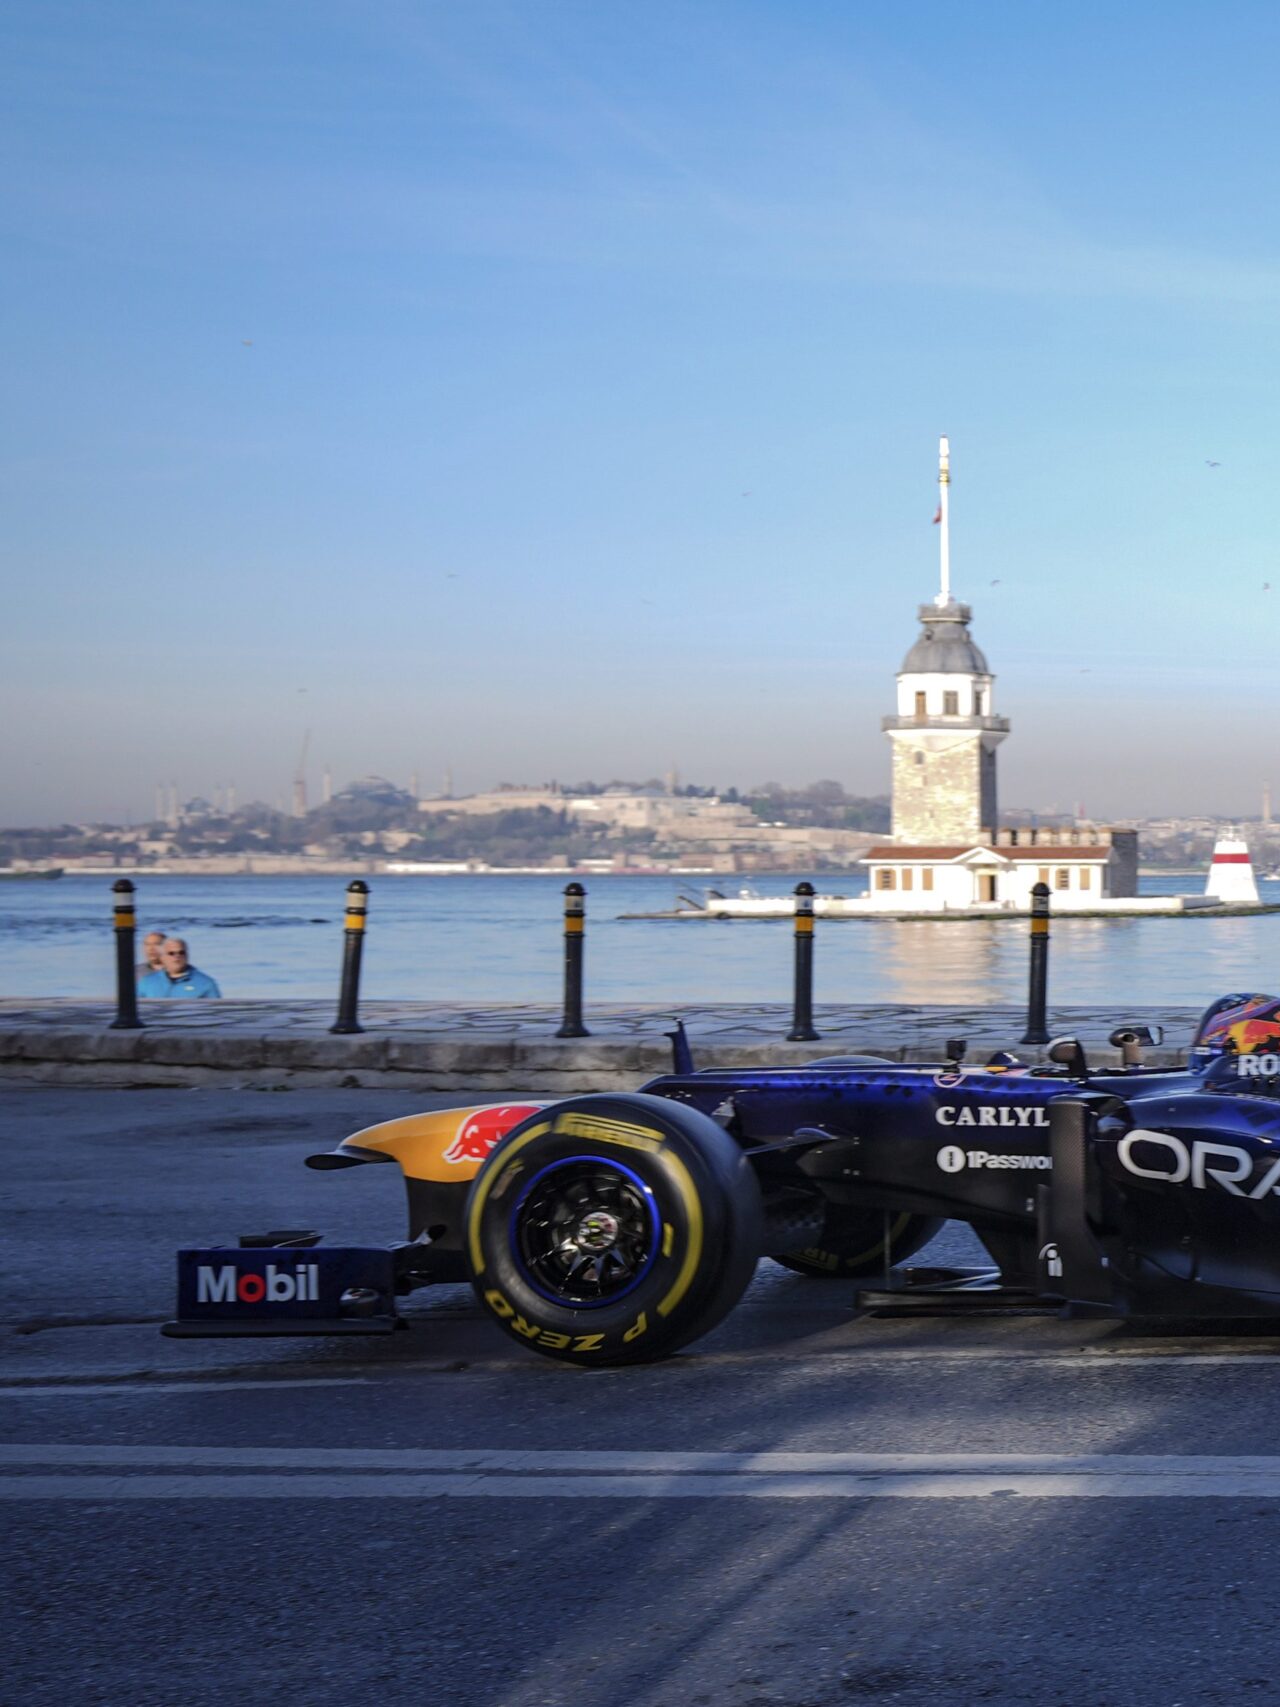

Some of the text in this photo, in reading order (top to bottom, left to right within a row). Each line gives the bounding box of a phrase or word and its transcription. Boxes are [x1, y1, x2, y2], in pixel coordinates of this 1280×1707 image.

[197, 1264, 319, 1303] Mobil
[485, 1289, 648, 1351] P ZERO
